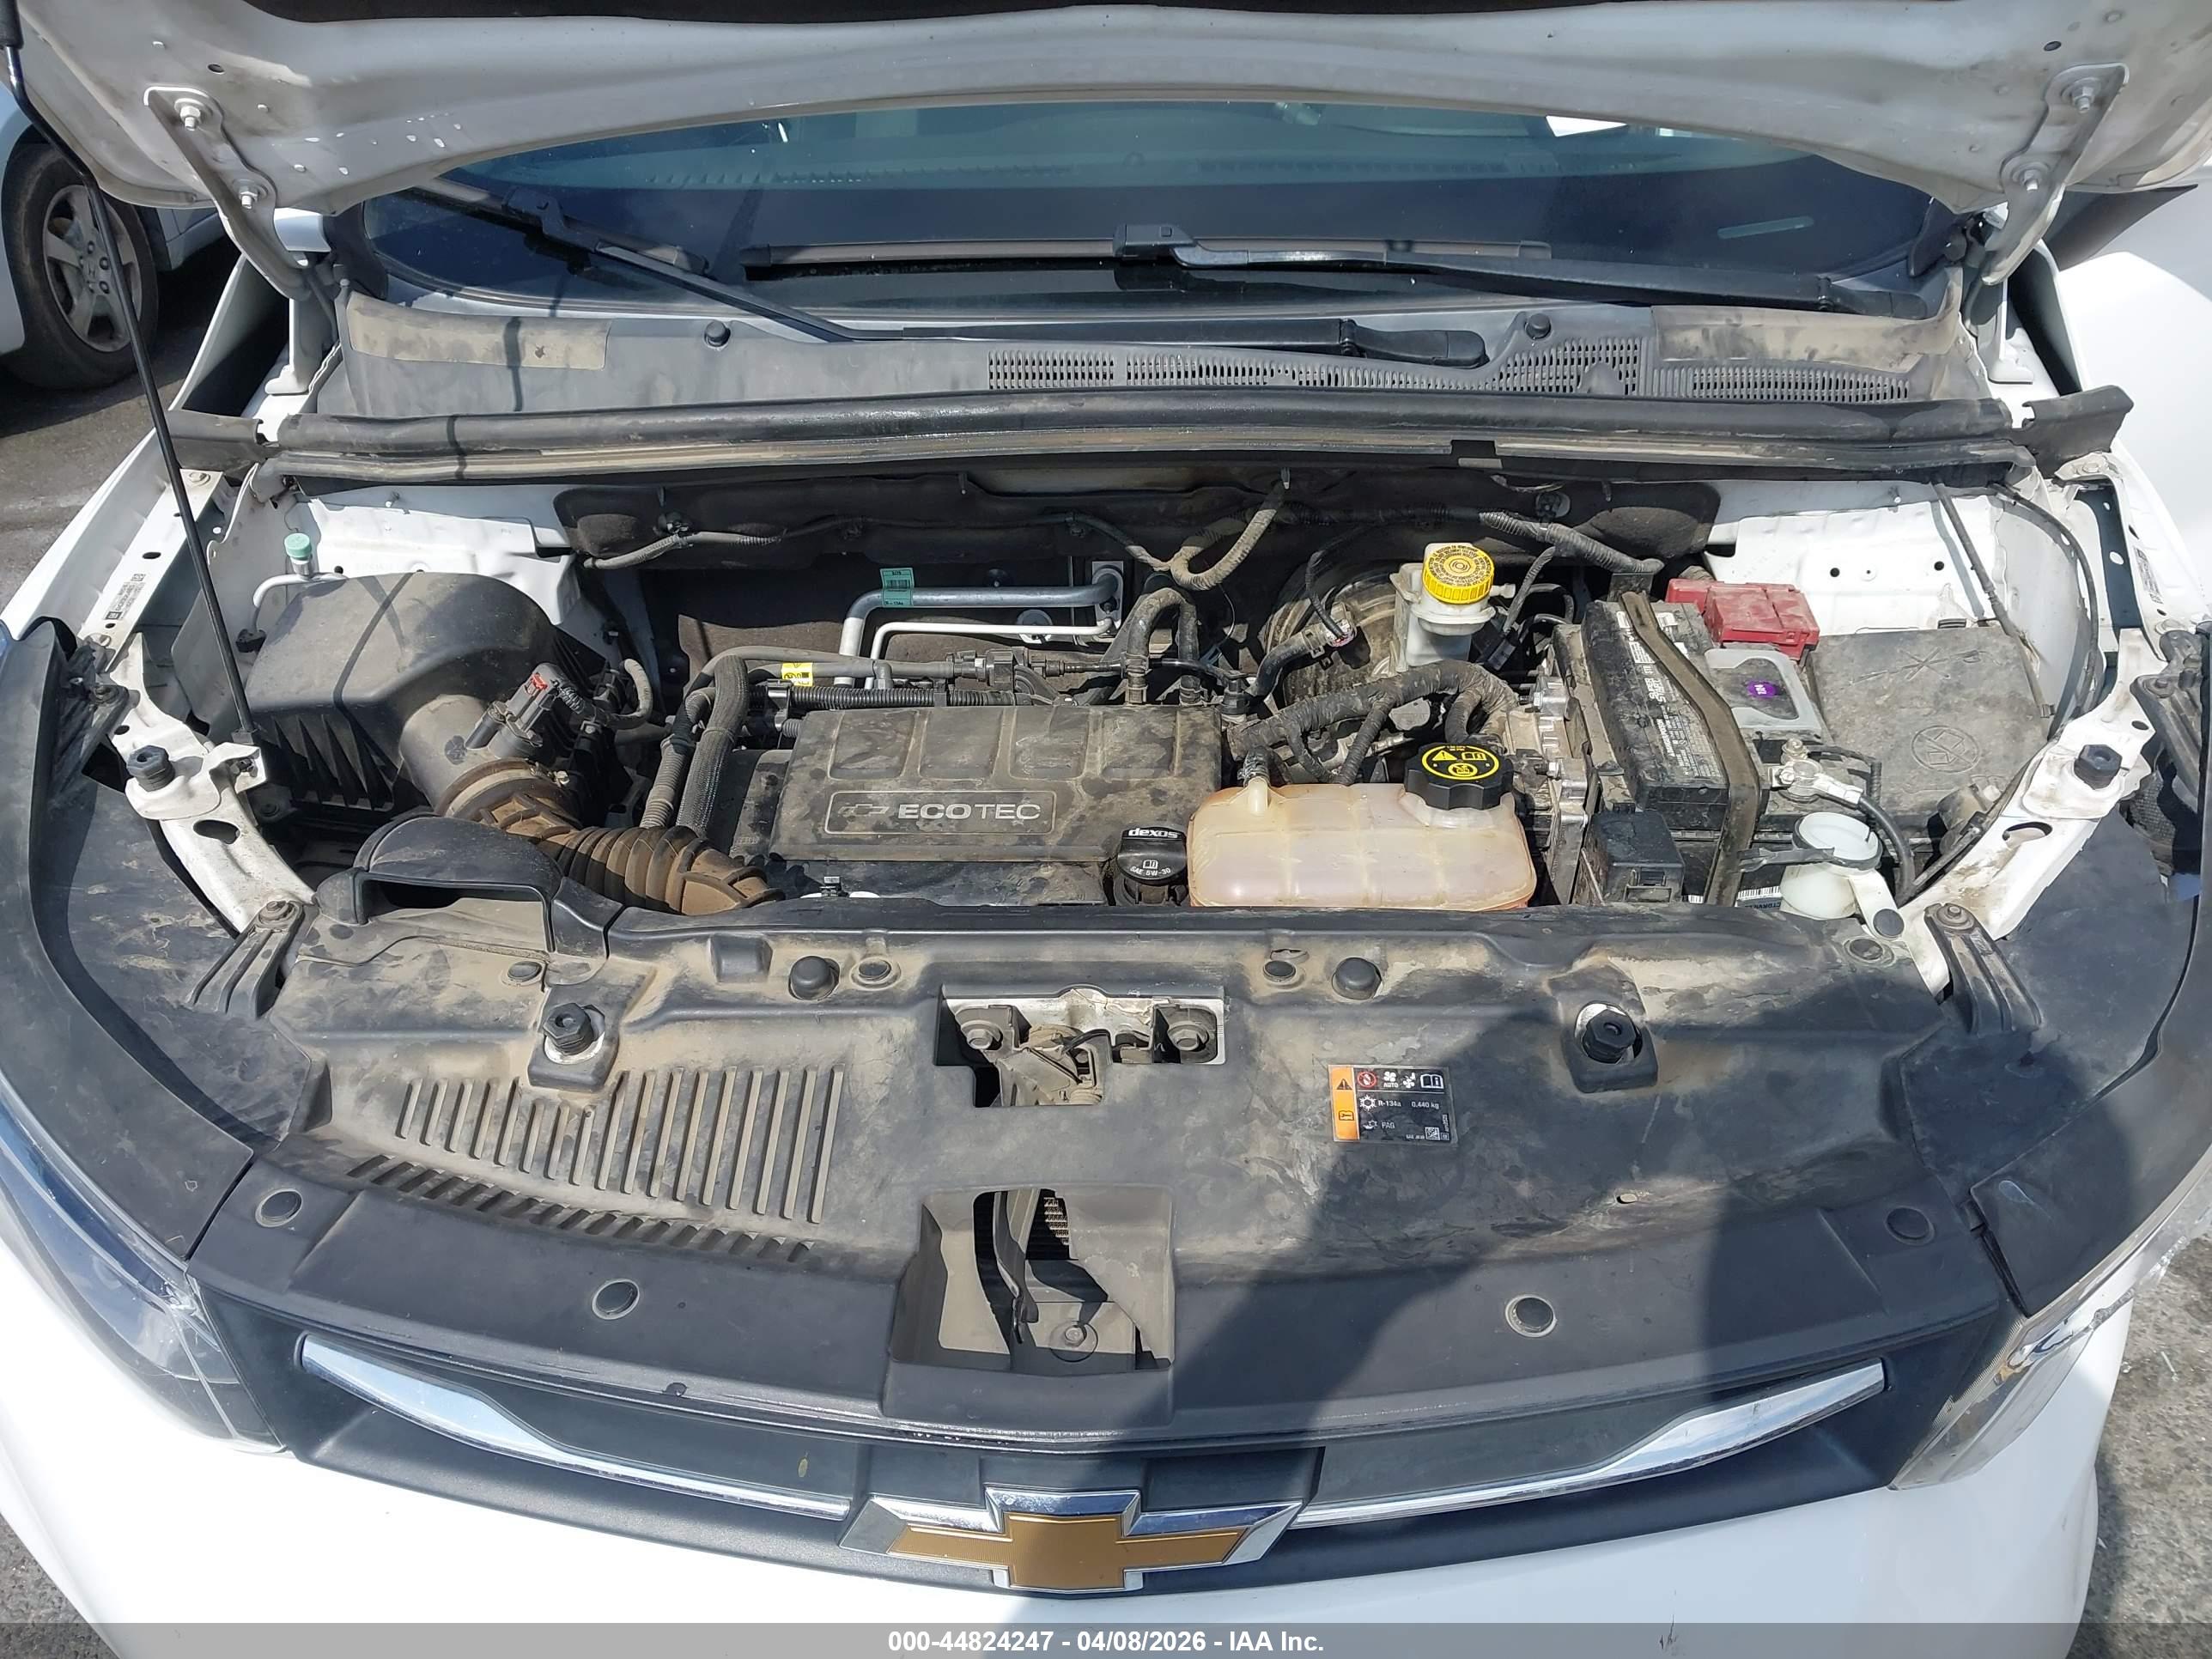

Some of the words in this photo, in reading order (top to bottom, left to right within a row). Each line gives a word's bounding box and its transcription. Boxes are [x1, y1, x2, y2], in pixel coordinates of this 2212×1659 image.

[897, 803, 1041, 820] ECOTEC
[1128, 828, 1182, 839] dexos
[1130, 866, 1145, 875] SAE
[1146, 867, 1171, 876] 5W-30
[1431, 1102, 1439, 1110] kg
